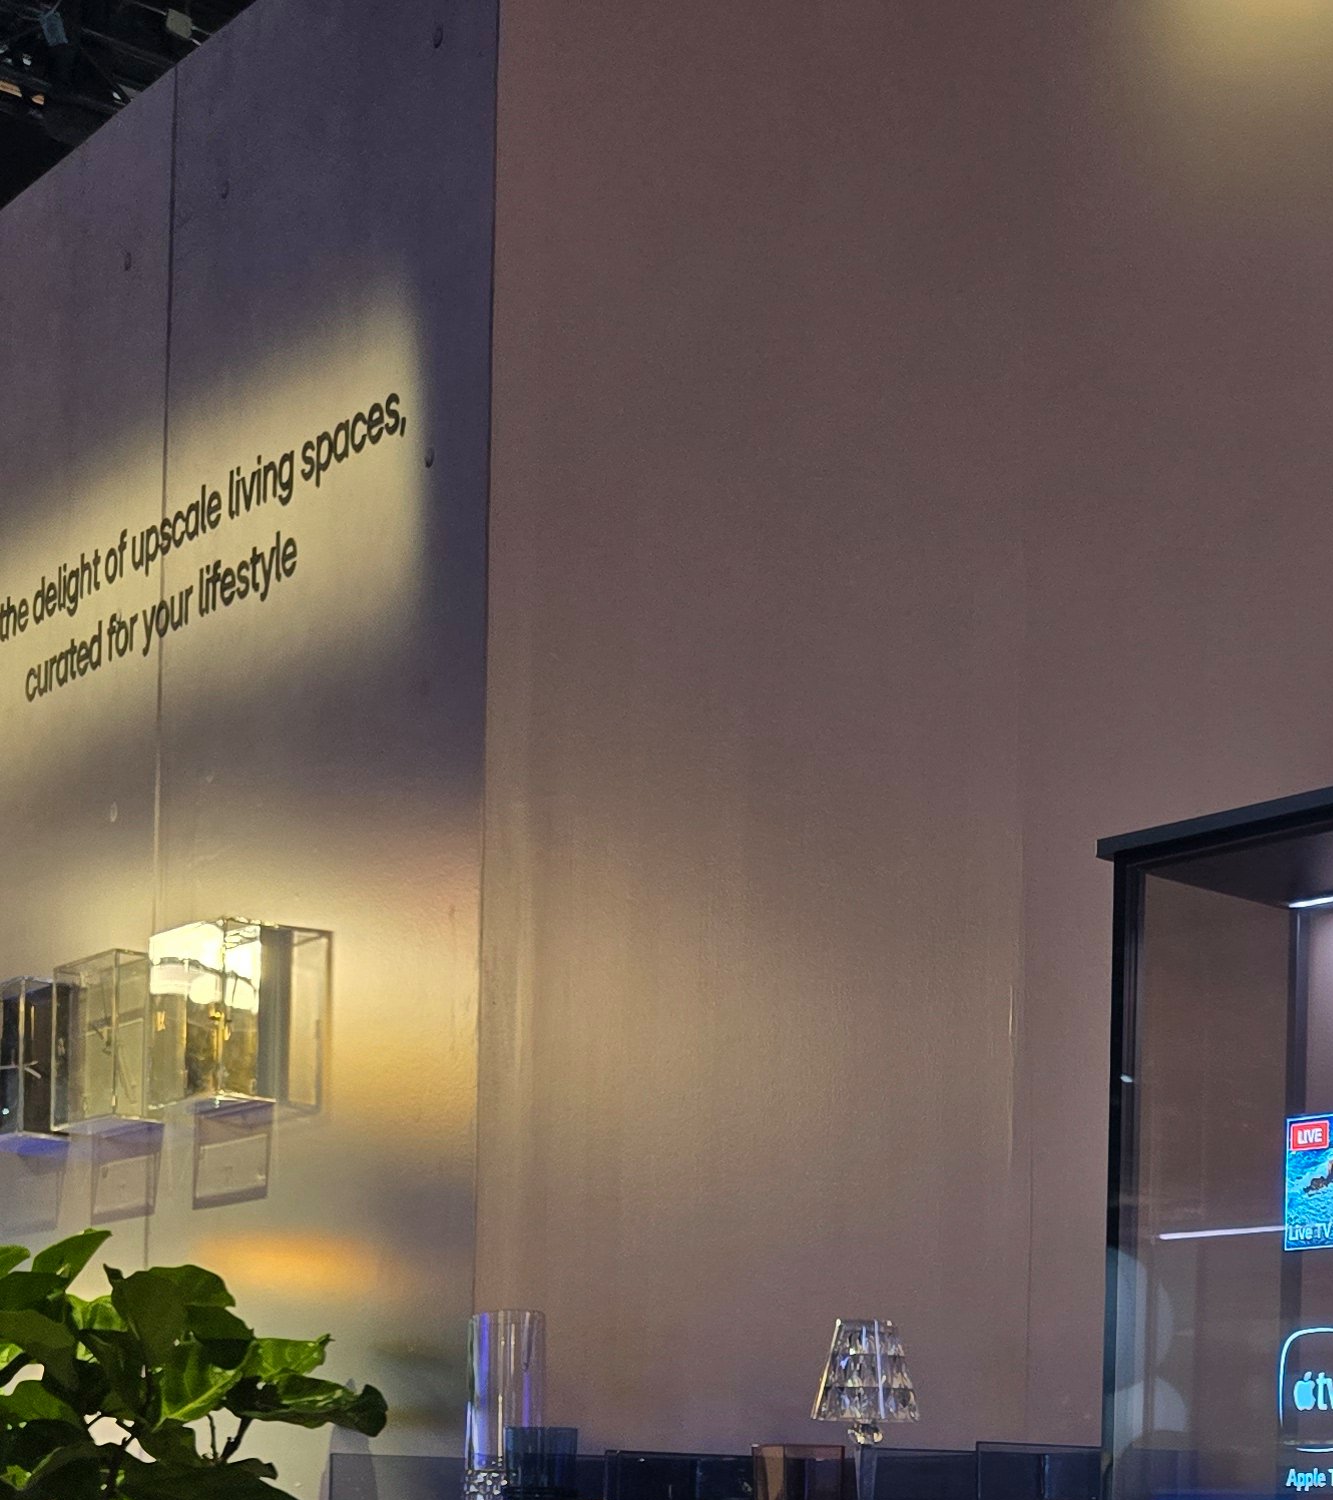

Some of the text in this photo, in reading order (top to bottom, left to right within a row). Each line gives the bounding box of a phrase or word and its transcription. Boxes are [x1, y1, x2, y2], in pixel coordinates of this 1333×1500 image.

[33, 549, 101, 626] delight
[105, 529, 127, 584] of
[131, 484, 222, 573] upscale
[228, 450, 295, 518] living
[300, 393, 407, 487] spaces,
[25, 531, 299, 702] curated for your lifestyle
[1295, 1126, 1323, 1147] LIVE
[1286, 1468, 1325, 1490] Apple
